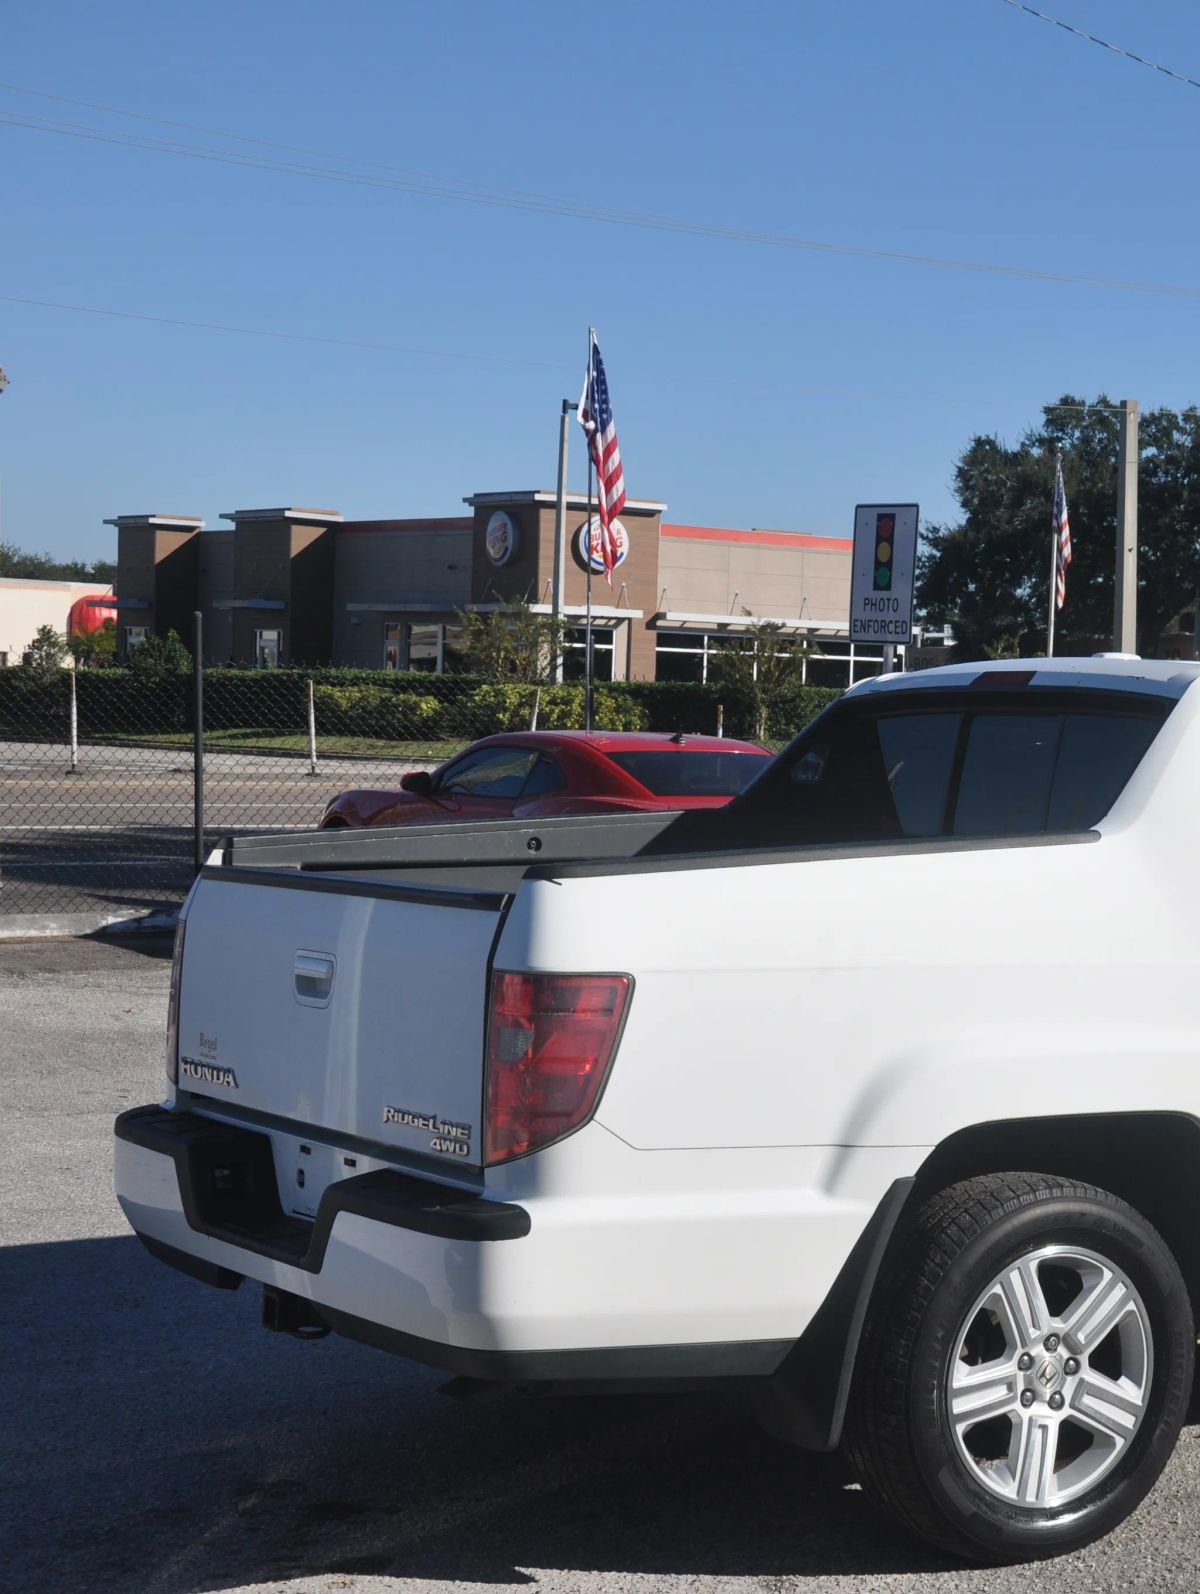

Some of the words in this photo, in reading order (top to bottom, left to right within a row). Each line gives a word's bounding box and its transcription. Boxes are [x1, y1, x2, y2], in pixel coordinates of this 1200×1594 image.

[863, 597, 899, 613] PHOTO
[853, 619, 908, 635] ENFORCED
[181, 1056, 239, 1088] HONDA
[383, 1104, 472, 1139] RIDGELINE
[429, 1135, 470, 1157] 4WD
